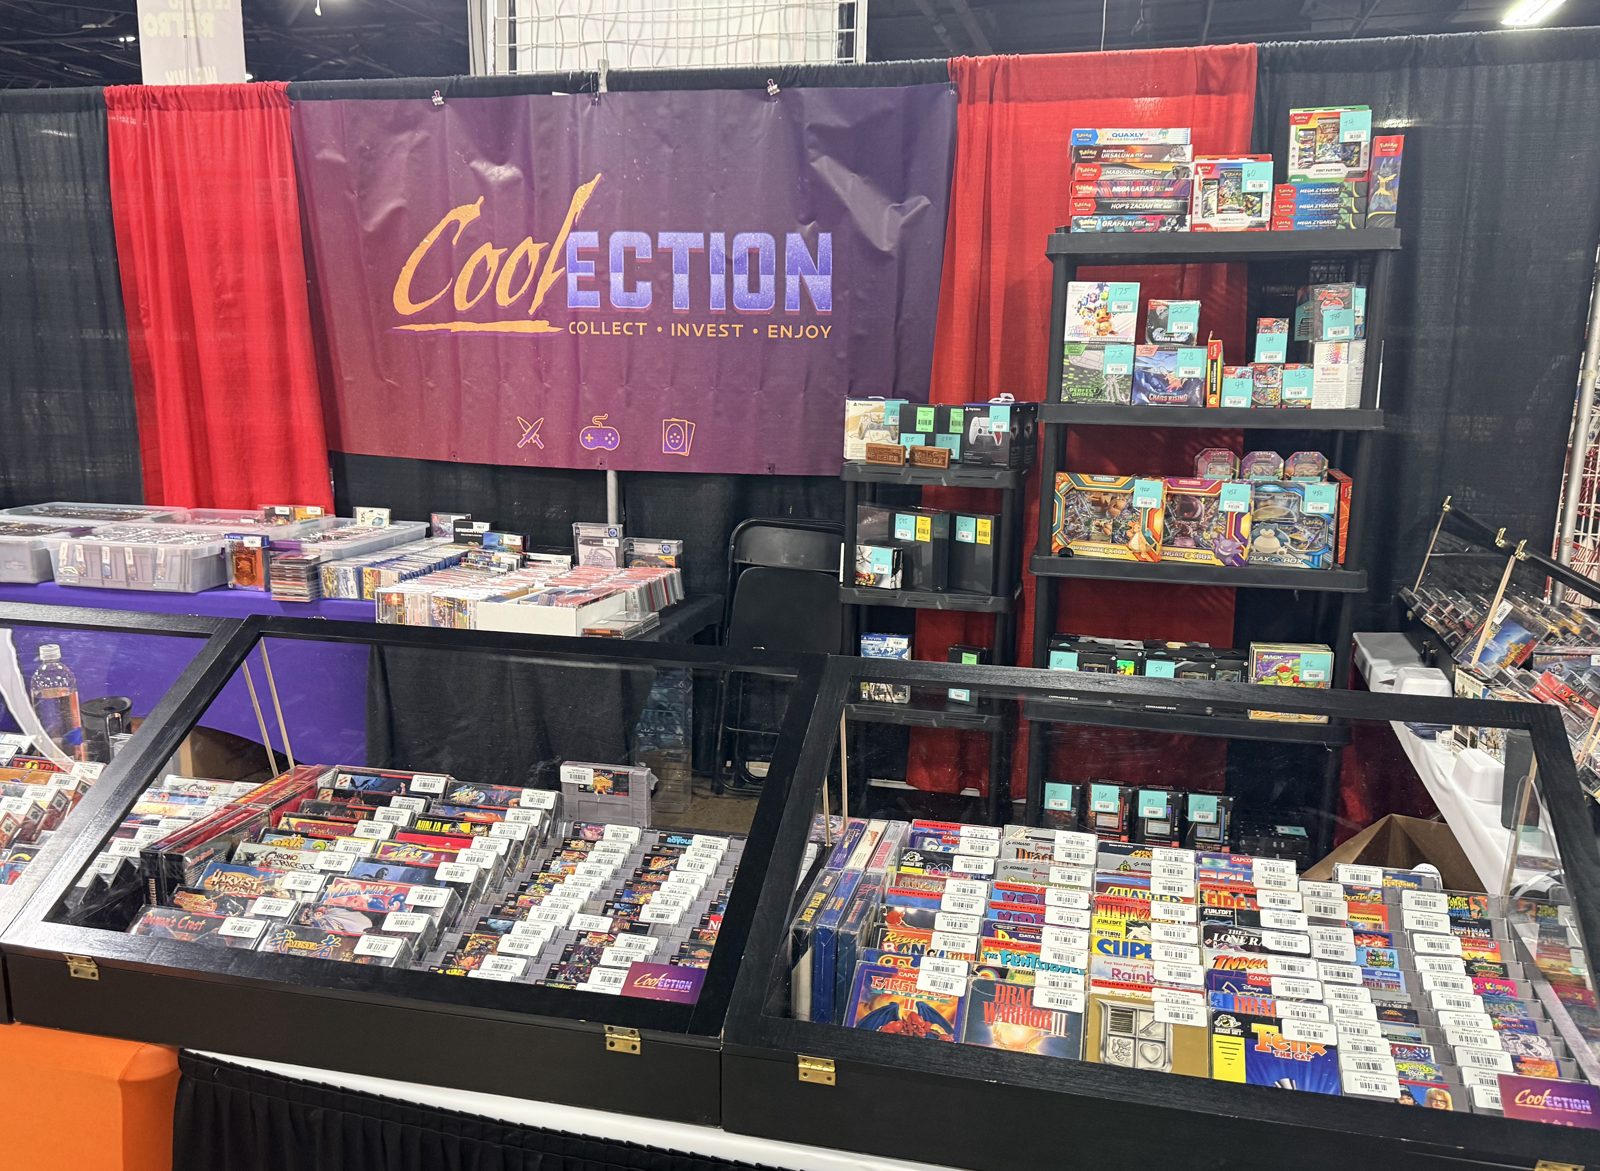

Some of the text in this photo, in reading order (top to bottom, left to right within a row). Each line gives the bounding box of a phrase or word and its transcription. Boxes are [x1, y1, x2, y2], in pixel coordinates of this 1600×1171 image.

[1114, 287, 1131, 296] 175
[567, 320, 832, 339] COLLECT INVEST ENJOY
[1149, 393, 1188, 401] CHAOS RISING
[1196, 552, 1212, 561] BOX
[1262, 653, 1283, 661] MAGIC
[264, 851, 299, 865] CHRONO
[210, 868, 263, 890] HARVEST
[362, 884, 388, 897] MAN
[1203, 908, 1234, 916] SUNSOFT
[177, 915, 207, 932] Crest
[1213, 932, 1248, 946] LONE
[1111, 967, 1157, 983] Rainb
[1273, 1050, 1312, 1061] THE CAT
